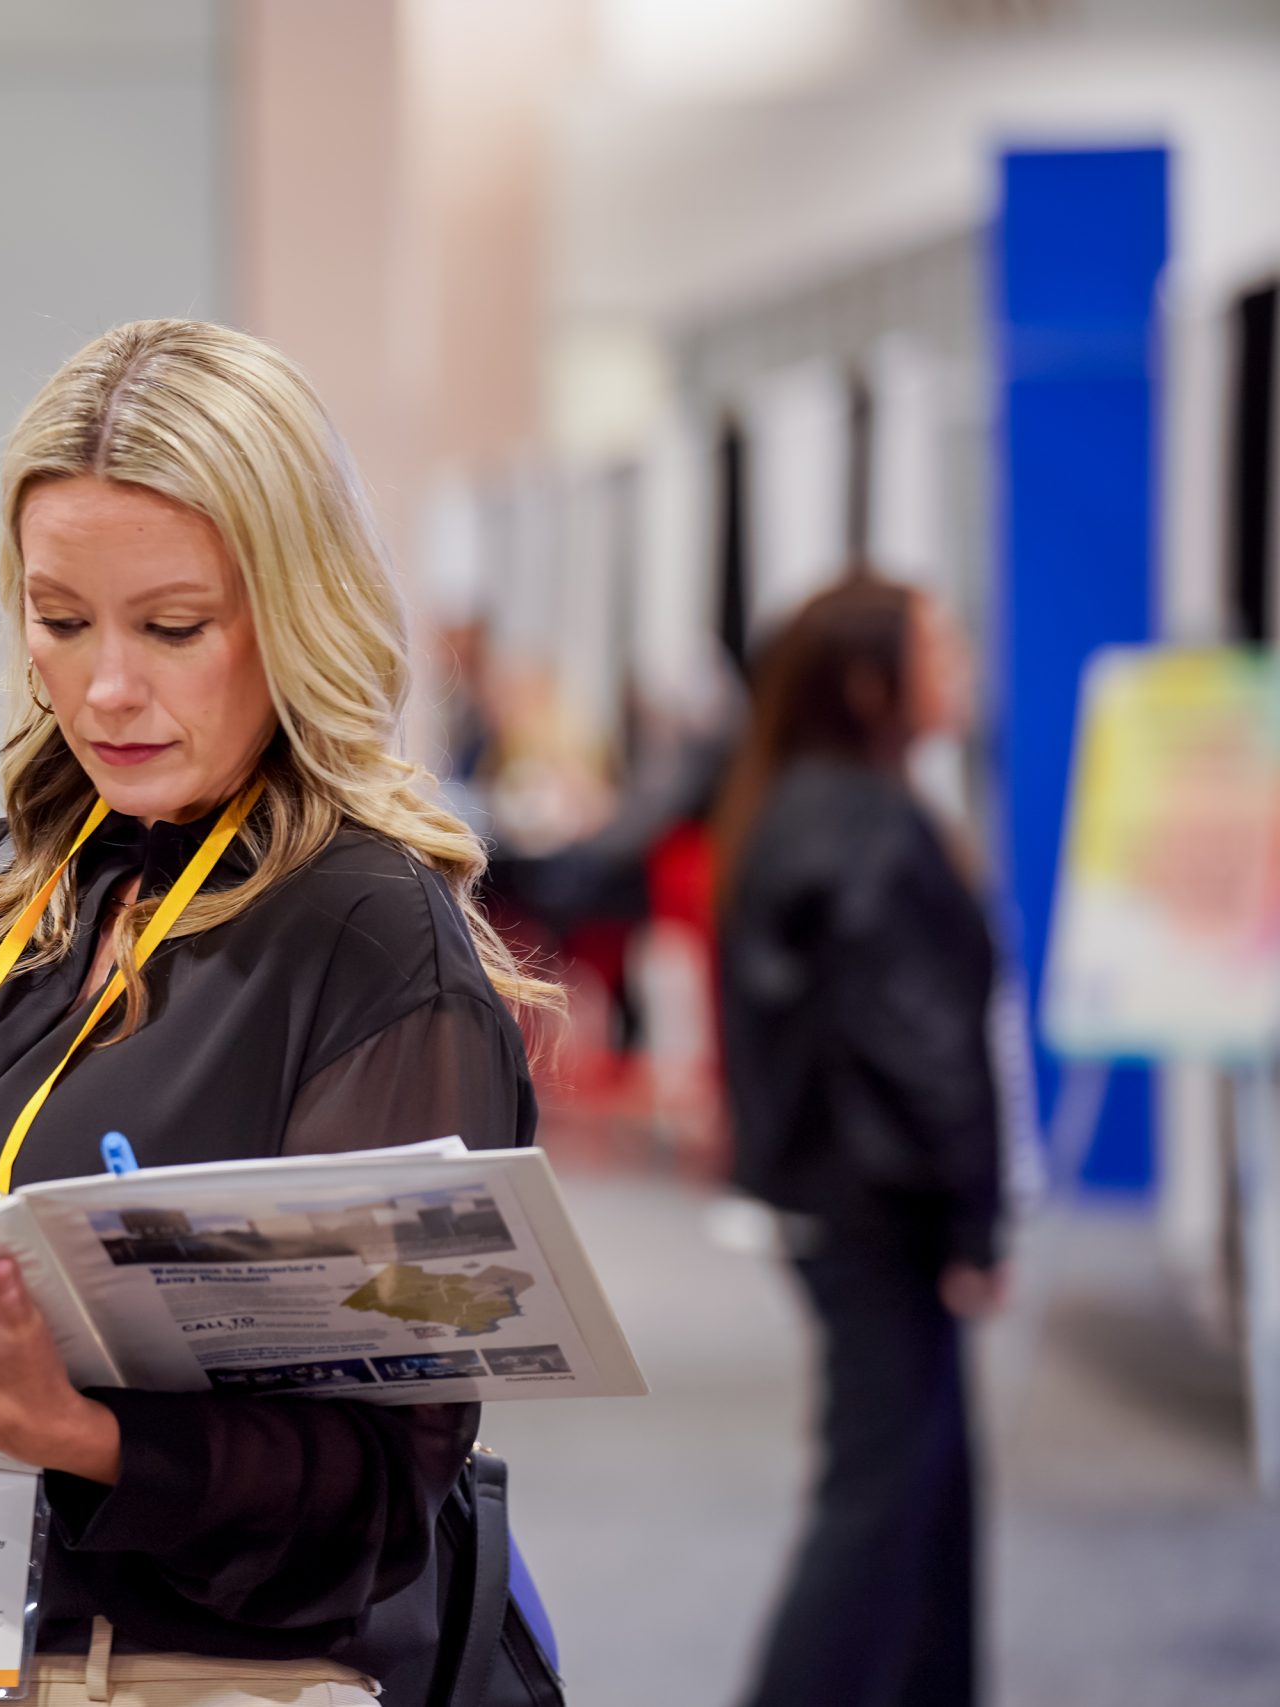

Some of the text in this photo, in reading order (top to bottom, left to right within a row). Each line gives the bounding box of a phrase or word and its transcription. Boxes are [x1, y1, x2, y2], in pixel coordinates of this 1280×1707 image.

[149, 1263, 326, 1276] Welcome to America's
[155, 1276, 195, 1285] Army
[182, 1320, 223, 1333] CALL
[227, 1317, 255, 1331] TO
